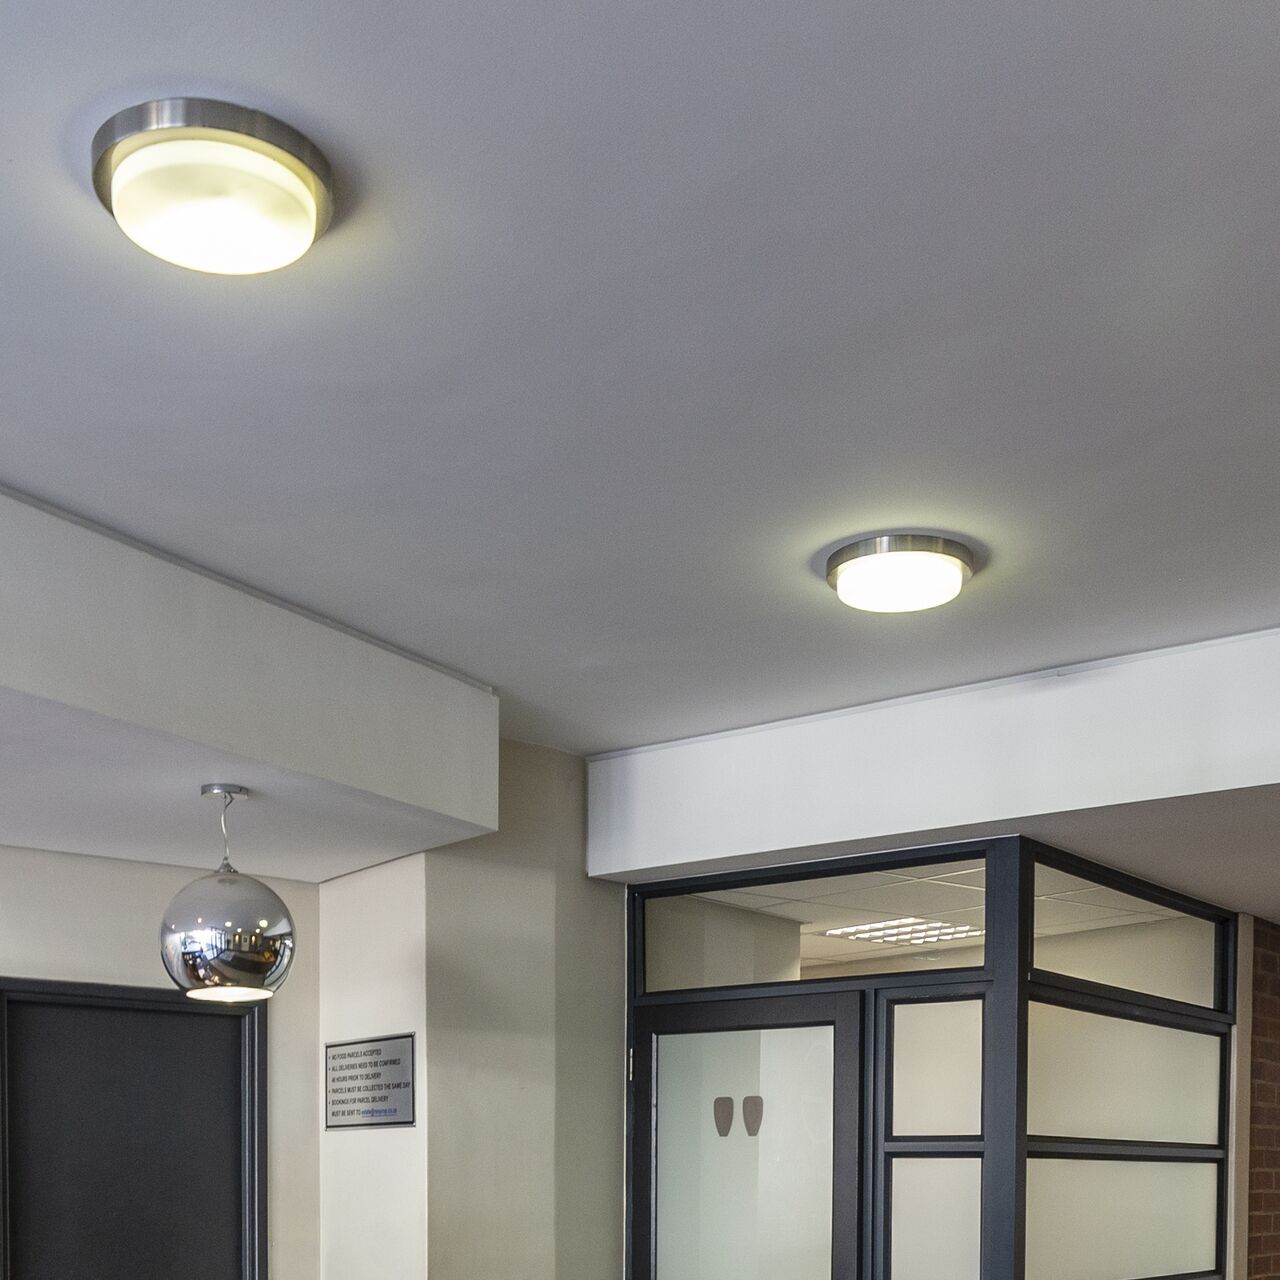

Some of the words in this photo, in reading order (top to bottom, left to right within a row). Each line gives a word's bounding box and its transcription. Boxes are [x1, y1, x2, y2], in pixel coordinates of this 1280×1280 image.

[339, 1063, 357, 1071] DELIVERIES
[379, 1058, 400, 1067] CONFIRMED
[365, 1072, 381, 1080] DELIVERY
[332, 1086, 346, 1094] PARCELS
[362, 1083, 383, 1092] COLLECTED
[332, 1098, 349, 1106] BOOKINGS
